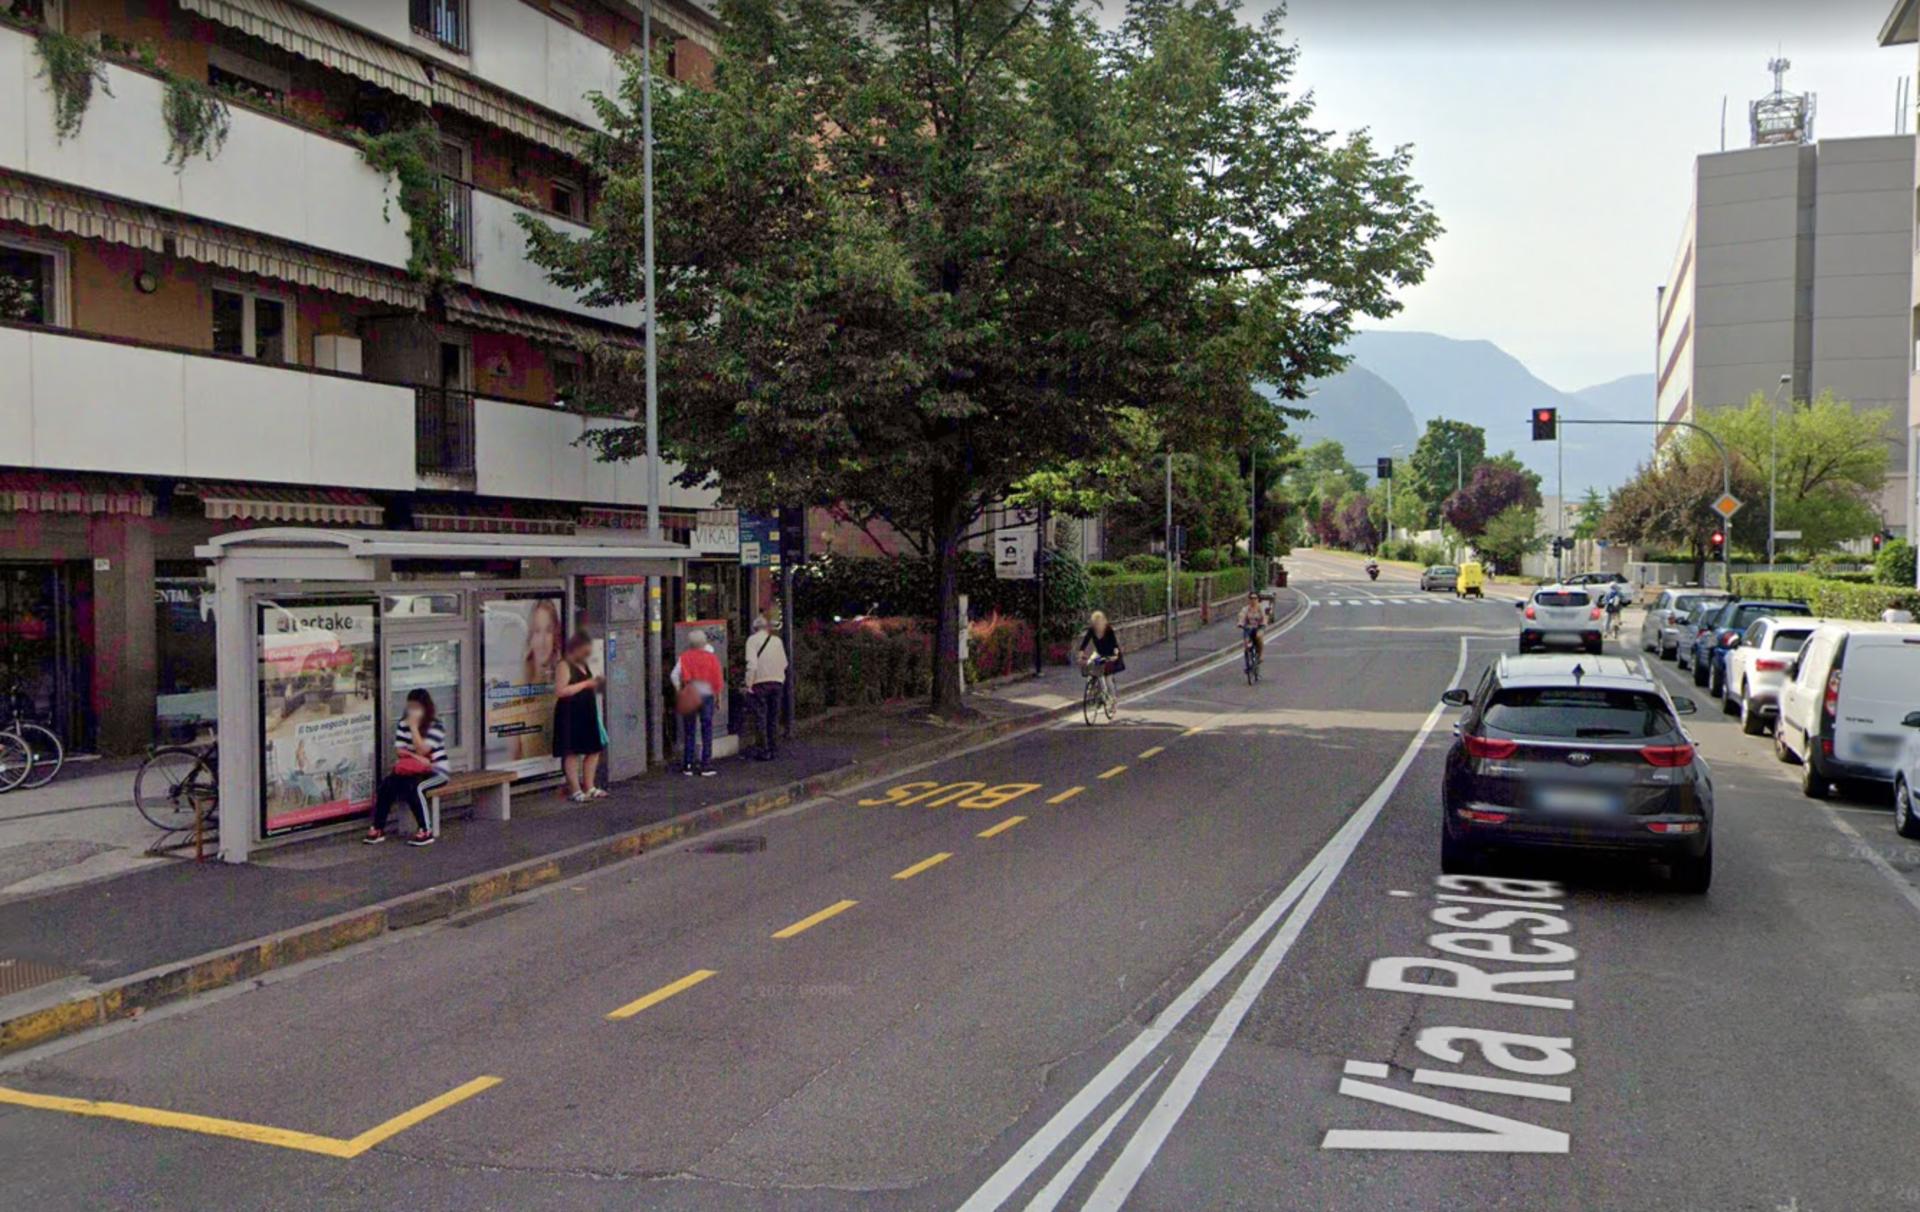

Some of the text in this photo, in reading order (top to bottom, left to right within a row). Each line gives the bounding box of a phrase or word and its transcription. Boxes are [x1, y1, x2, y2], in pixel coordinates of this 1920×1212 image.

[694, 528, 738, 545] VIKAD
[858, 781, 1042, 809] BUS
[1321, 874, 1578, 1153] Via Resia
